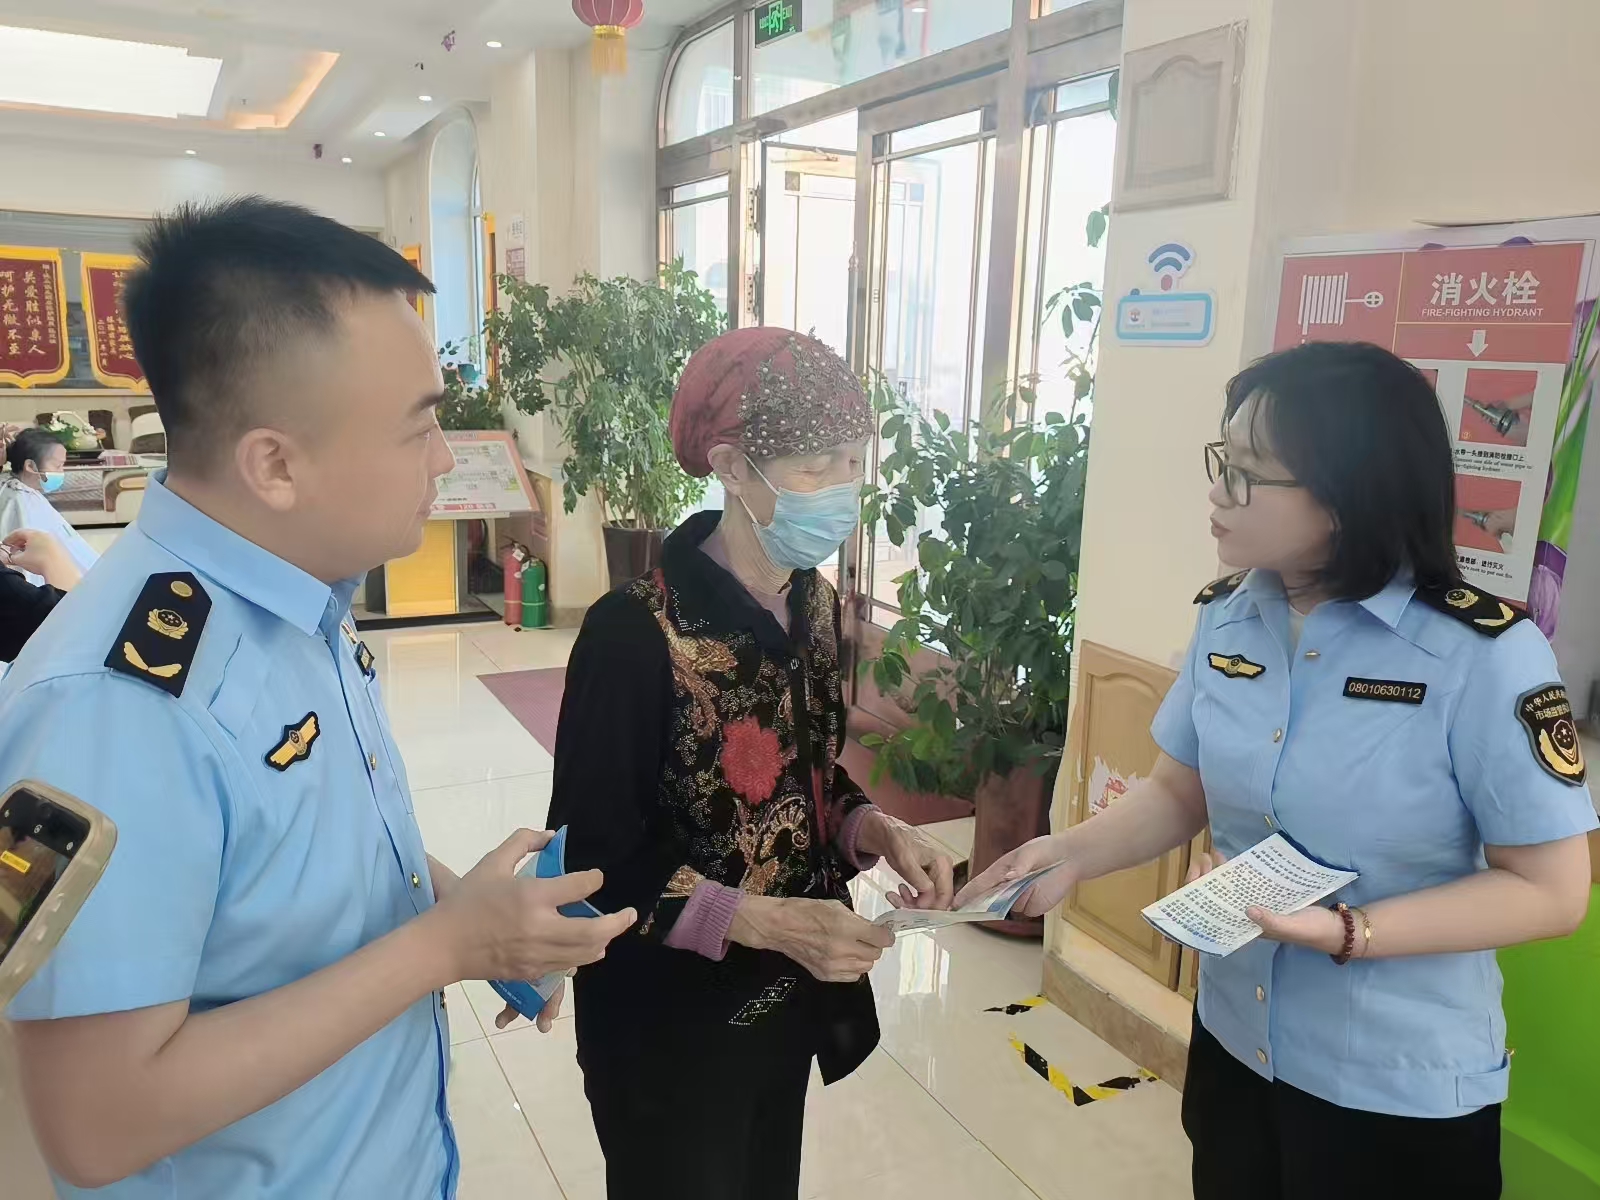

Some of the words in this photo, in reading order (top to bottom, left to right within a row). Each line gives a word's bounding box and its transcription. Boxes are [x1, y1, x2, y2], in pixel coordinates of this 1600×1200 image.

[1430, 270, 1541, 306] 消火栓
[1421, 308, 1490, 317] FIRE-FIGHTING
[1493, 307, 1544, 317] HYDRANT
[1348, 682, 1421, 699] 08010630112
